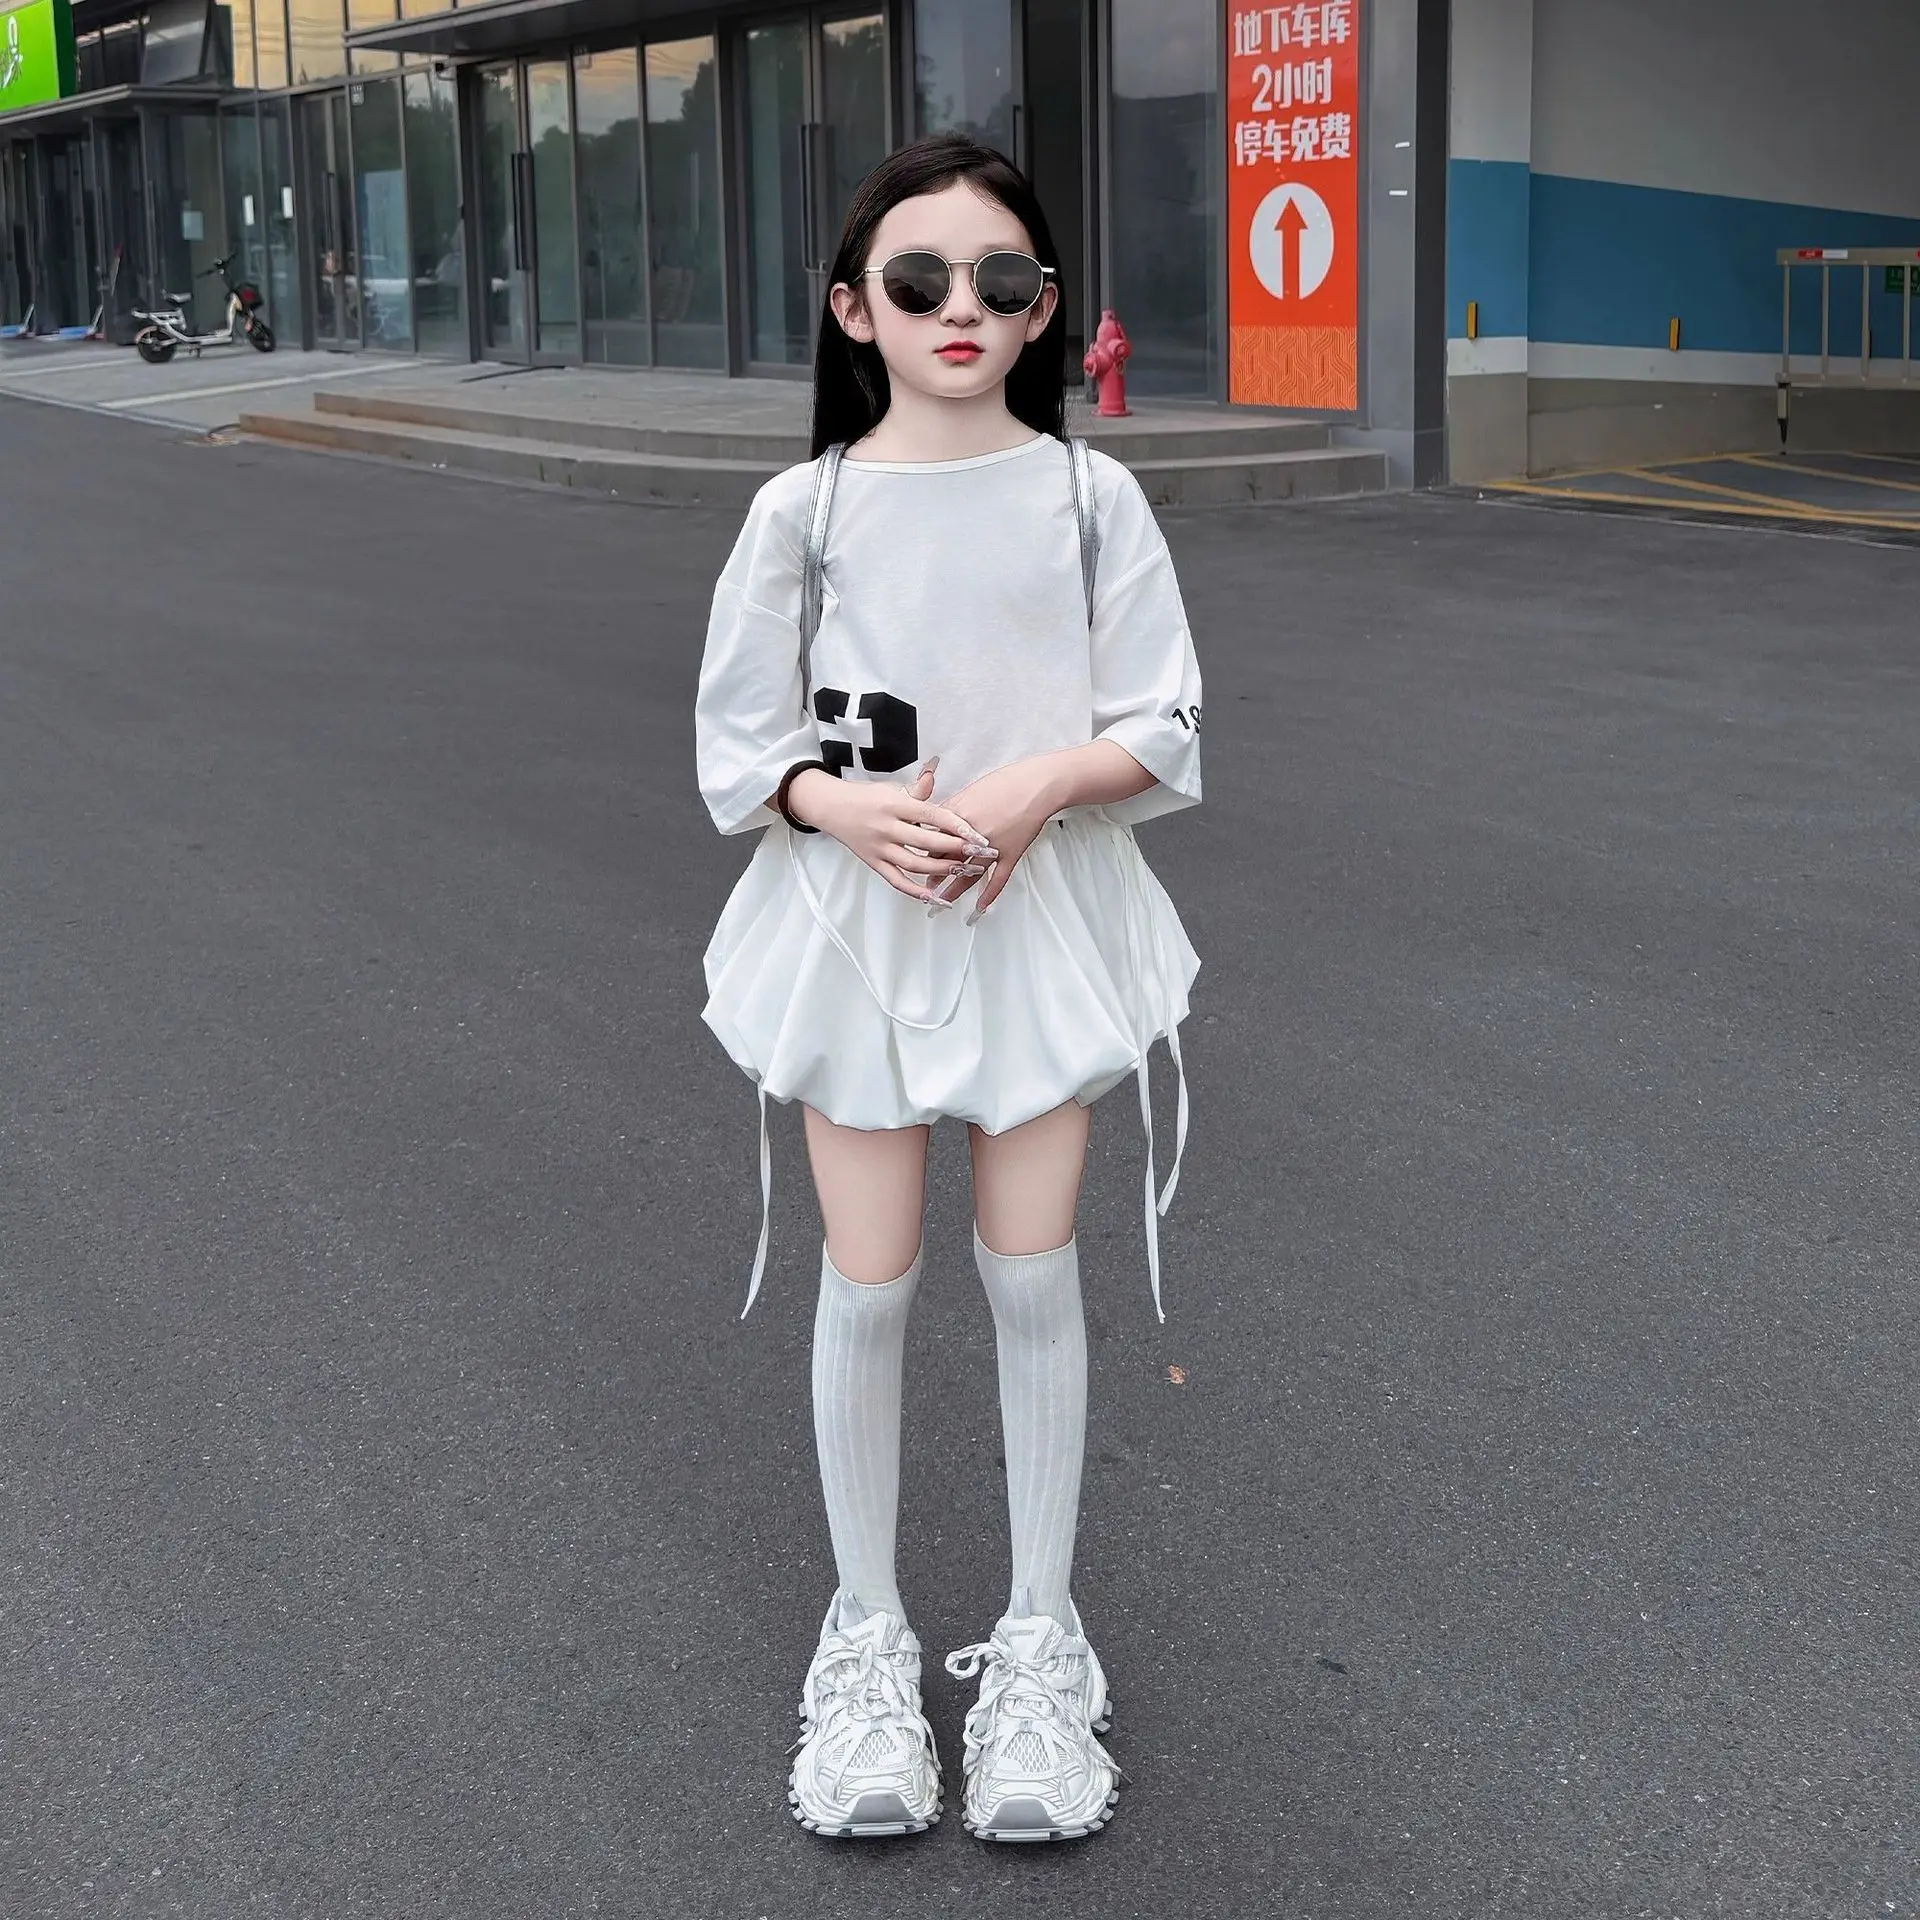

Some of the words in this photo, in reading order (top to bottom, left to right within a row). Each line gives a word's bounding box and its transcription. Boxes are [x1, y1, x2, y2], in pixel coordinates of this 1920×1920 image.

[1234, 0, 1350, 57] 地下车库
[1252, 57, 1332, 112] 2小时
[1235, 112, 1350, 166] 停车免费
